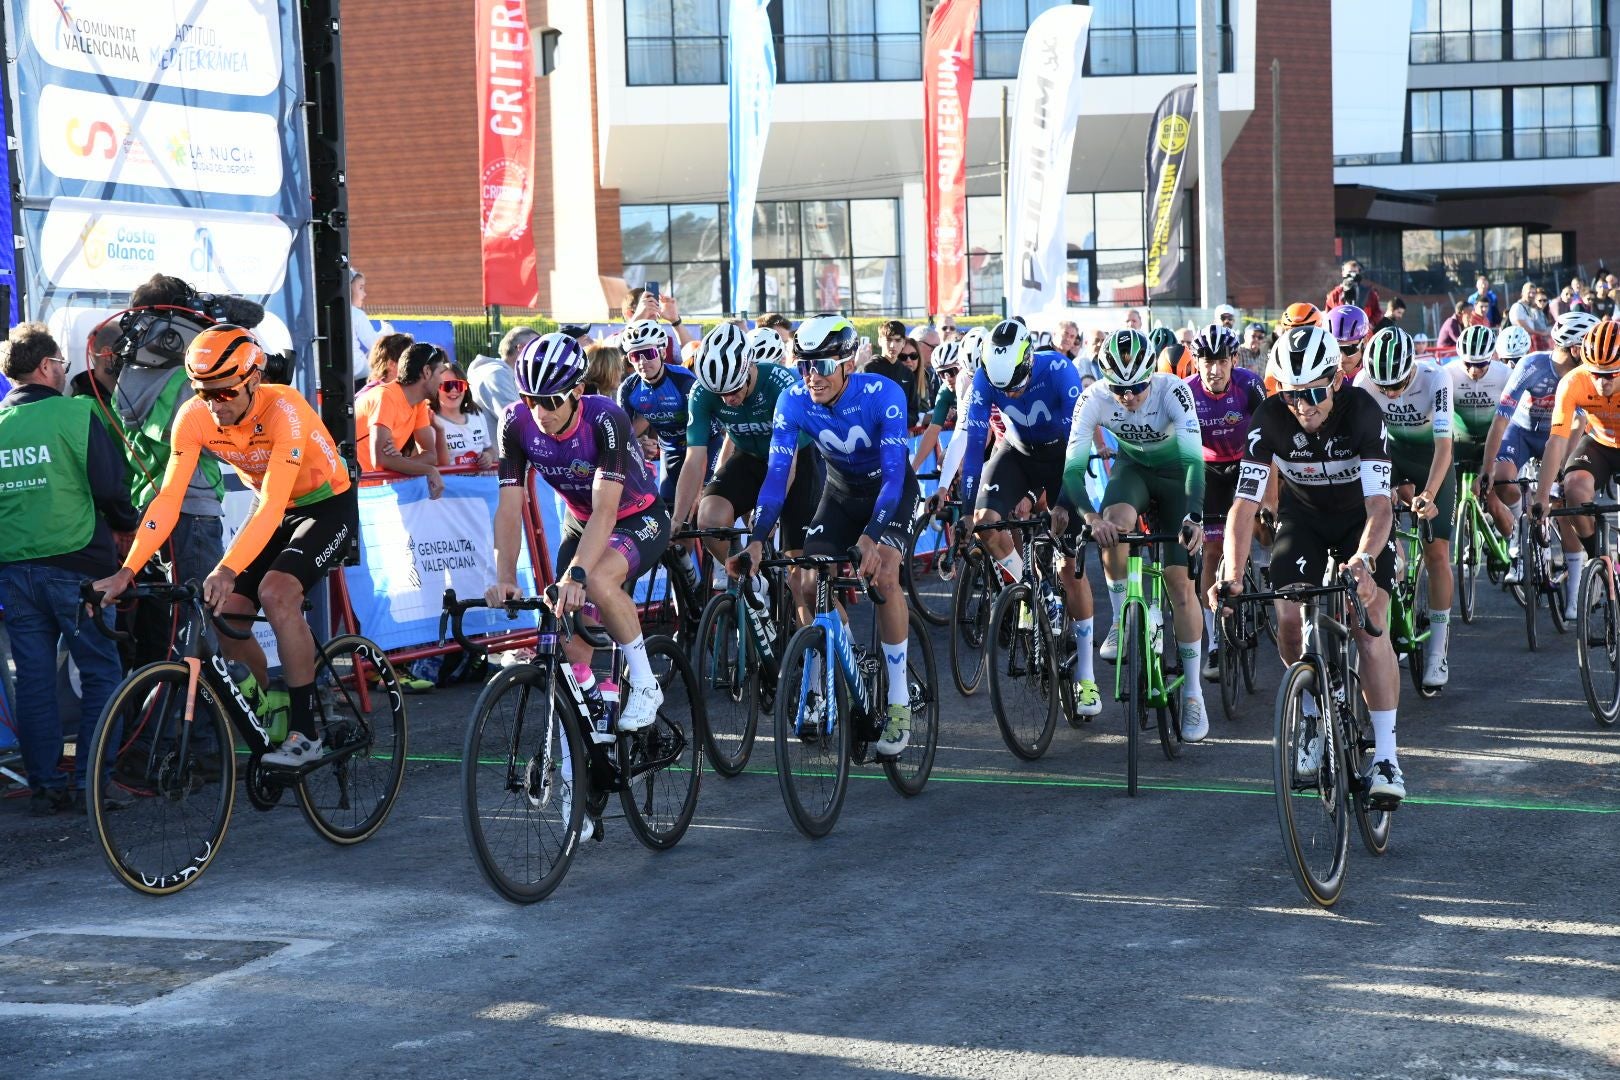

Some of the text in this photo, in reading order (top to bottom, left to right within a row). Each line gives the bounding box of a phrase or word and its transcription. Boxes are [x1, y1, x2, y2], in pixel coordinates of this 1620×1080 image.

[76, 18, 137, 41] COMUNITAT
[63, 33, 140, 63] VALENCIANA
[938, 47, 962, 193] CRITERIUM
[117, 227, 156, 245] Costa
[107, 243, 156, 262] Blanca
[770, 366, 796, 387] KER
[1172, 388, 1190, 413] RGA
[1463, 391, 1489, 399] CAJA
[276, 397, 302, 441] euskaltel
[1384, 411, 1427, 422] RURAL
[1387, 403, 1417, 414] CAJA
[603, 418, 616, 450] CORTIZO
[1120, 423, 1155, 433] CAJA
[310, 430, 338, 473] ORBEA
[1372, 464, 1392, 477] ep
[315, 523, 348, 568] euskaltel
[422, 556, 477, 573] VALENCIANA
[211, 654, 271, 748] ORBEA
